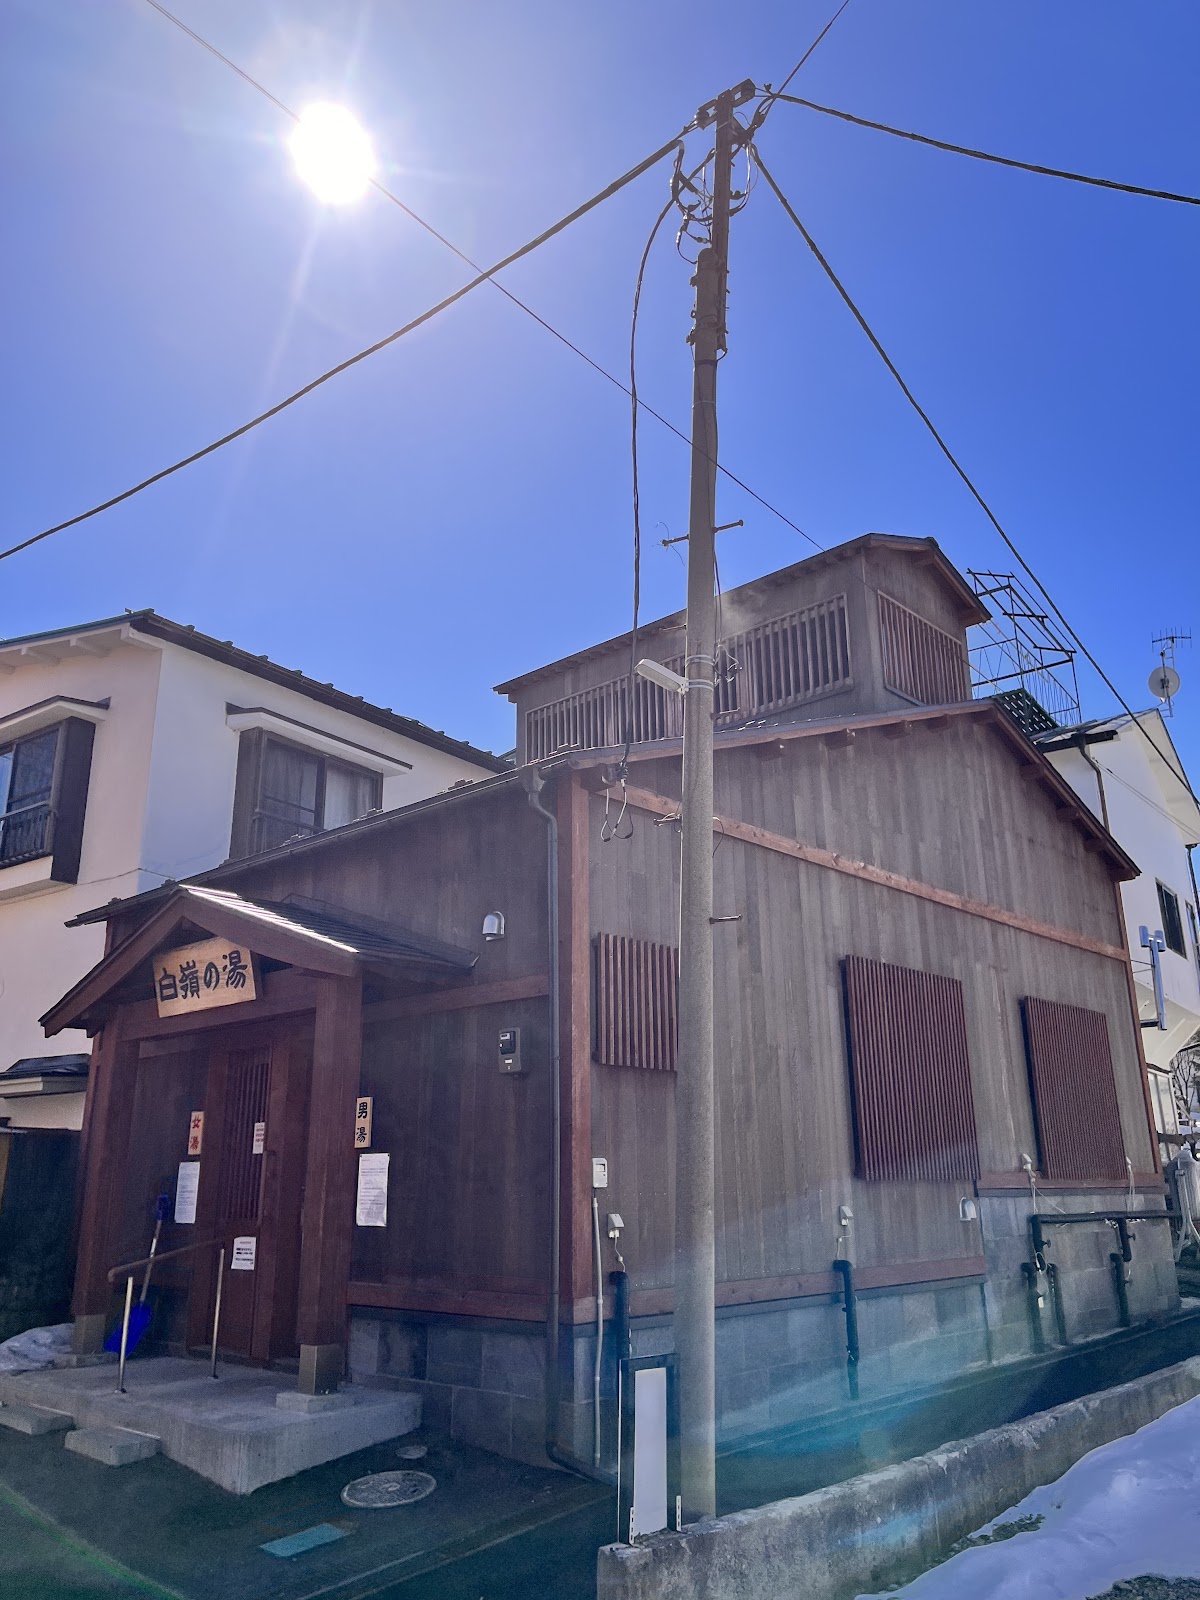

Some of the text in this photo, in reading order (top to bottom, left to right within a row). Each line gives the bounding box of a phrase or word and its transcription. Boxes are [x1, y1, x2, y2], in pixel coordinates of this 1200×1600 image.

[158, 949, 248, 1003] 白嶺の湯
[190, 1115, 201, 1151] 女湯
[355, 1101, 368, 1143] 男湯
